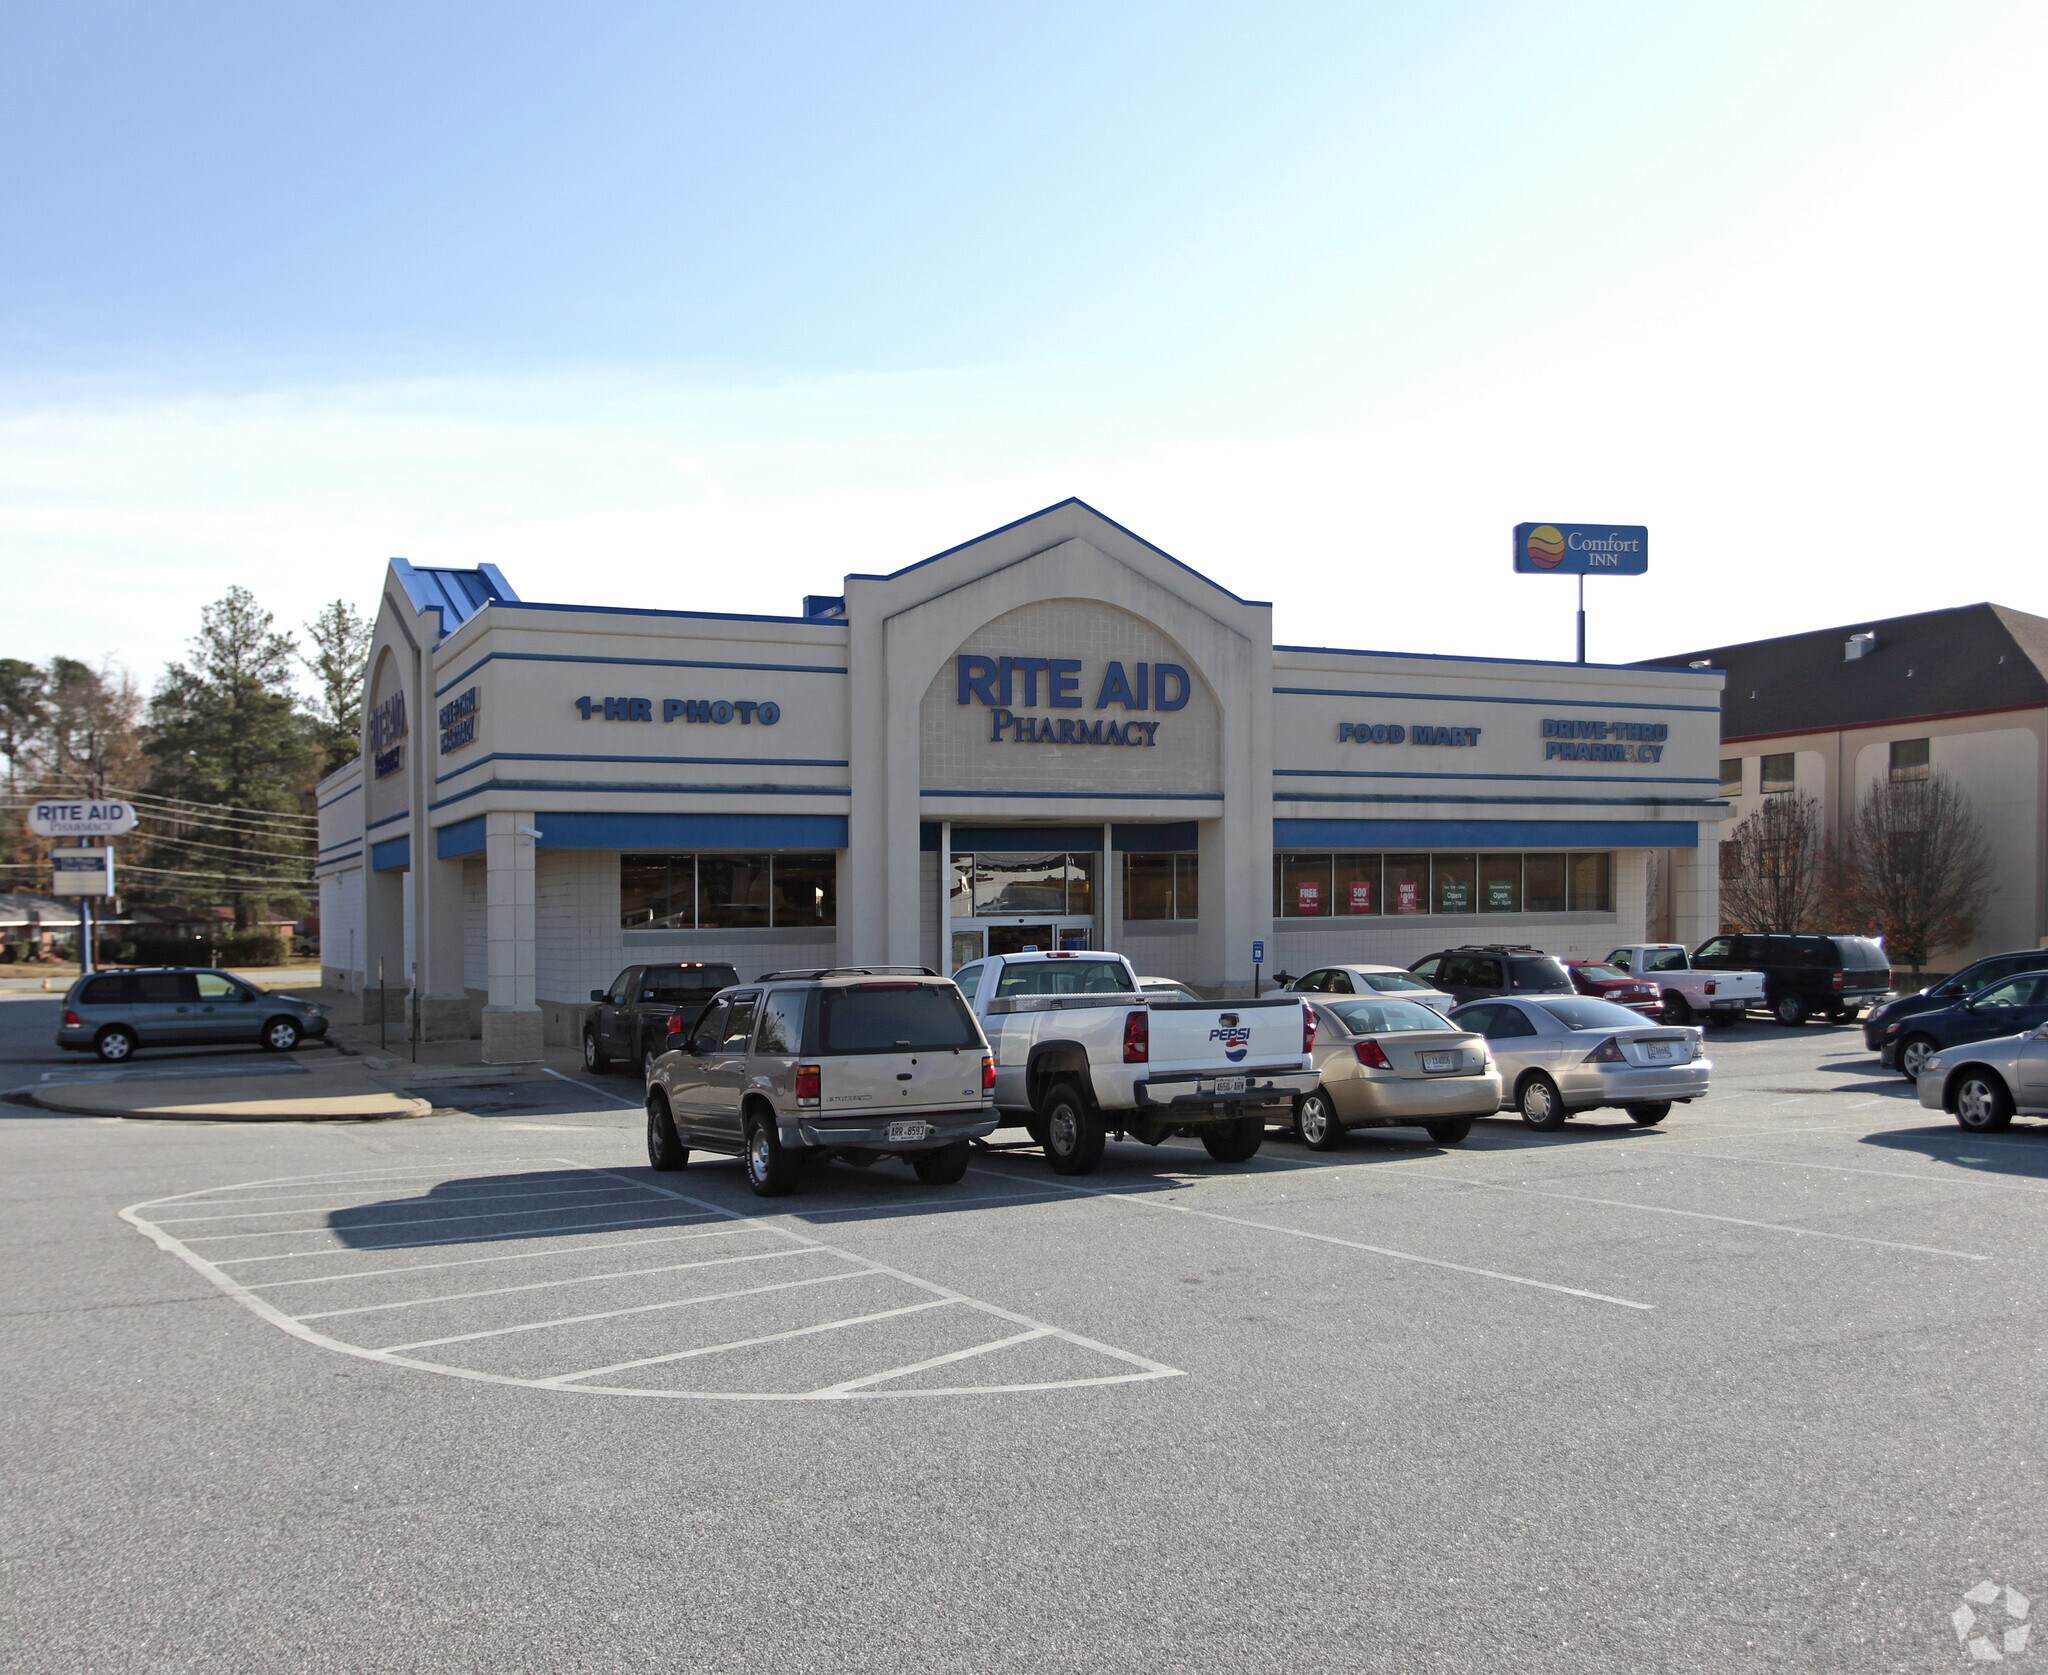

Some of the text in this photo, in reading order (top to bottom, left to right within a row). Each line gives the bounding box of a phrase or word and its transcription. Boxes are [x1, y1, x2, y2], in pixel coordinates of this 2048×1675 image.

[1568, 532, 1639, 552] Comfort
[1588, 553, 1618, 567] INN
[957, 655, 1190, 711] RITE AID
[575, 696, 781, 725] 1-HR PHOTO
[990, 708, 1160, 747] PHARMACY
[1542, 719, 1668, 742] DRIVE-THRU
[1339, 723, 1481, 747] FOOD MART
[1545, 741, 1664, 763] PHARMCY
[37, 806, 123, 820] RITE AID
[50, 822, 112, 832] PHARMACY
[1300, 888, 1318, 898] FREE
[1353, 888, 1366, 897] 500
[1400, 884, 1415, 892] ONLY
[1493, 891, 1508, 899] Open
[1209, 1028, 1250, 1041] PEPSI
